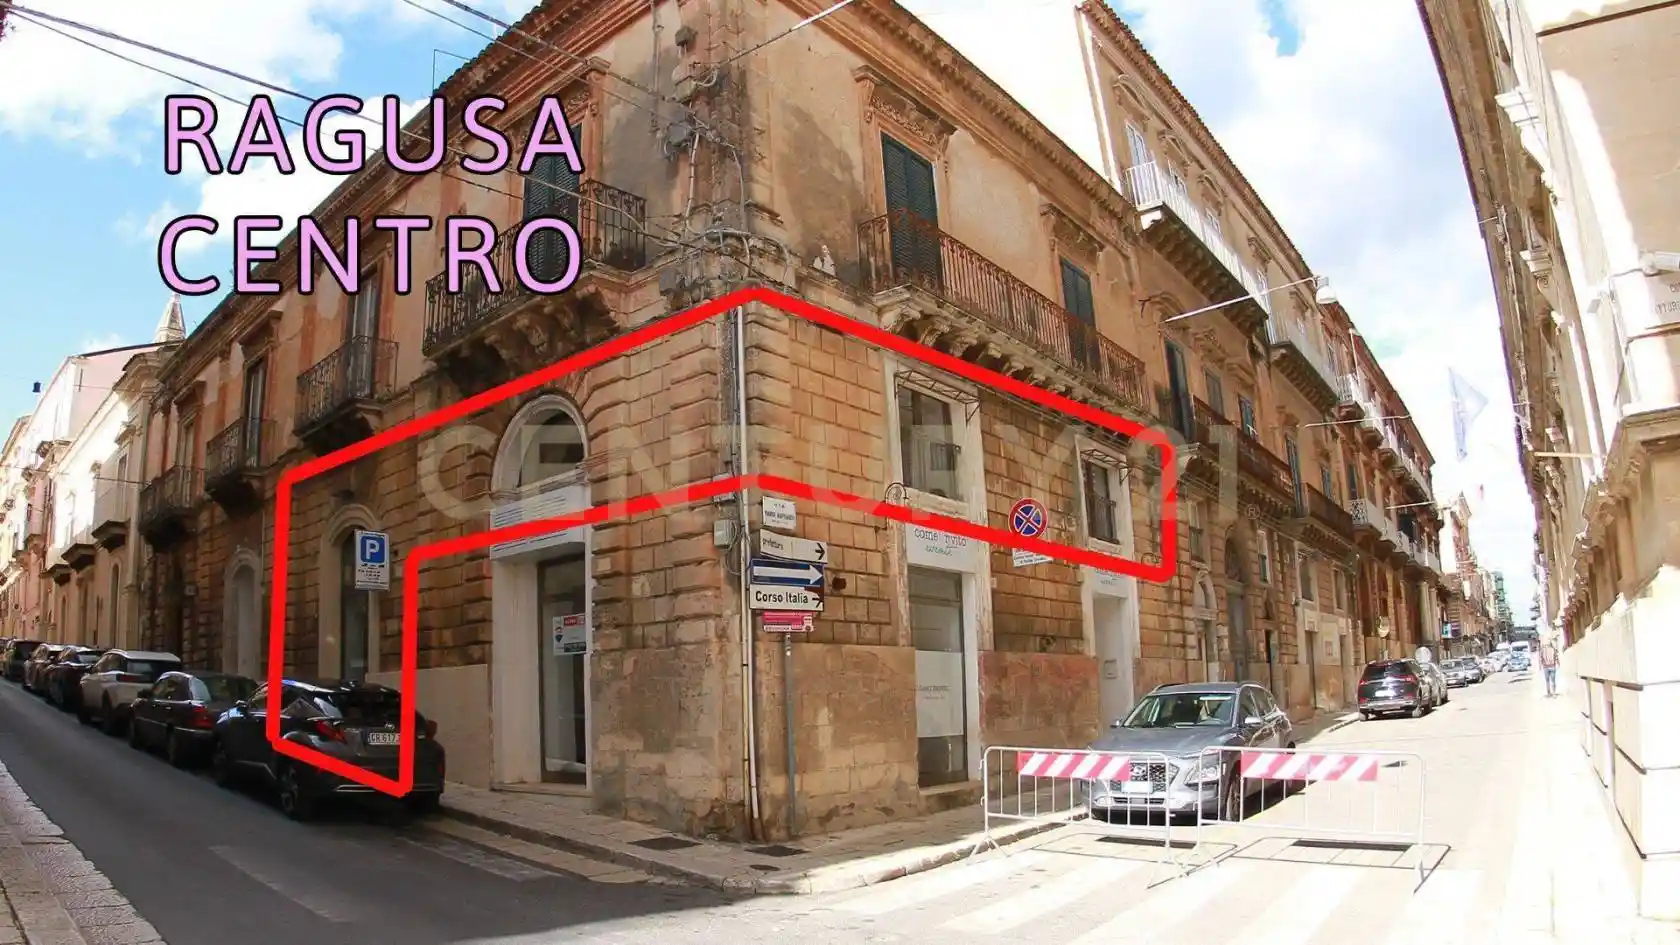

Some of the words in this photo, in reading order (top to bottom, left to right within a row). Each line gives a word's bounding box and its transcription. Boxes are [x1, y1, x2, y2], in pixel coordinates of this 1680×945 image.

[366, 539, 380, 560] P
[755, 590, 783, 603] Corso
[785, 591, 808, 604] Italia
